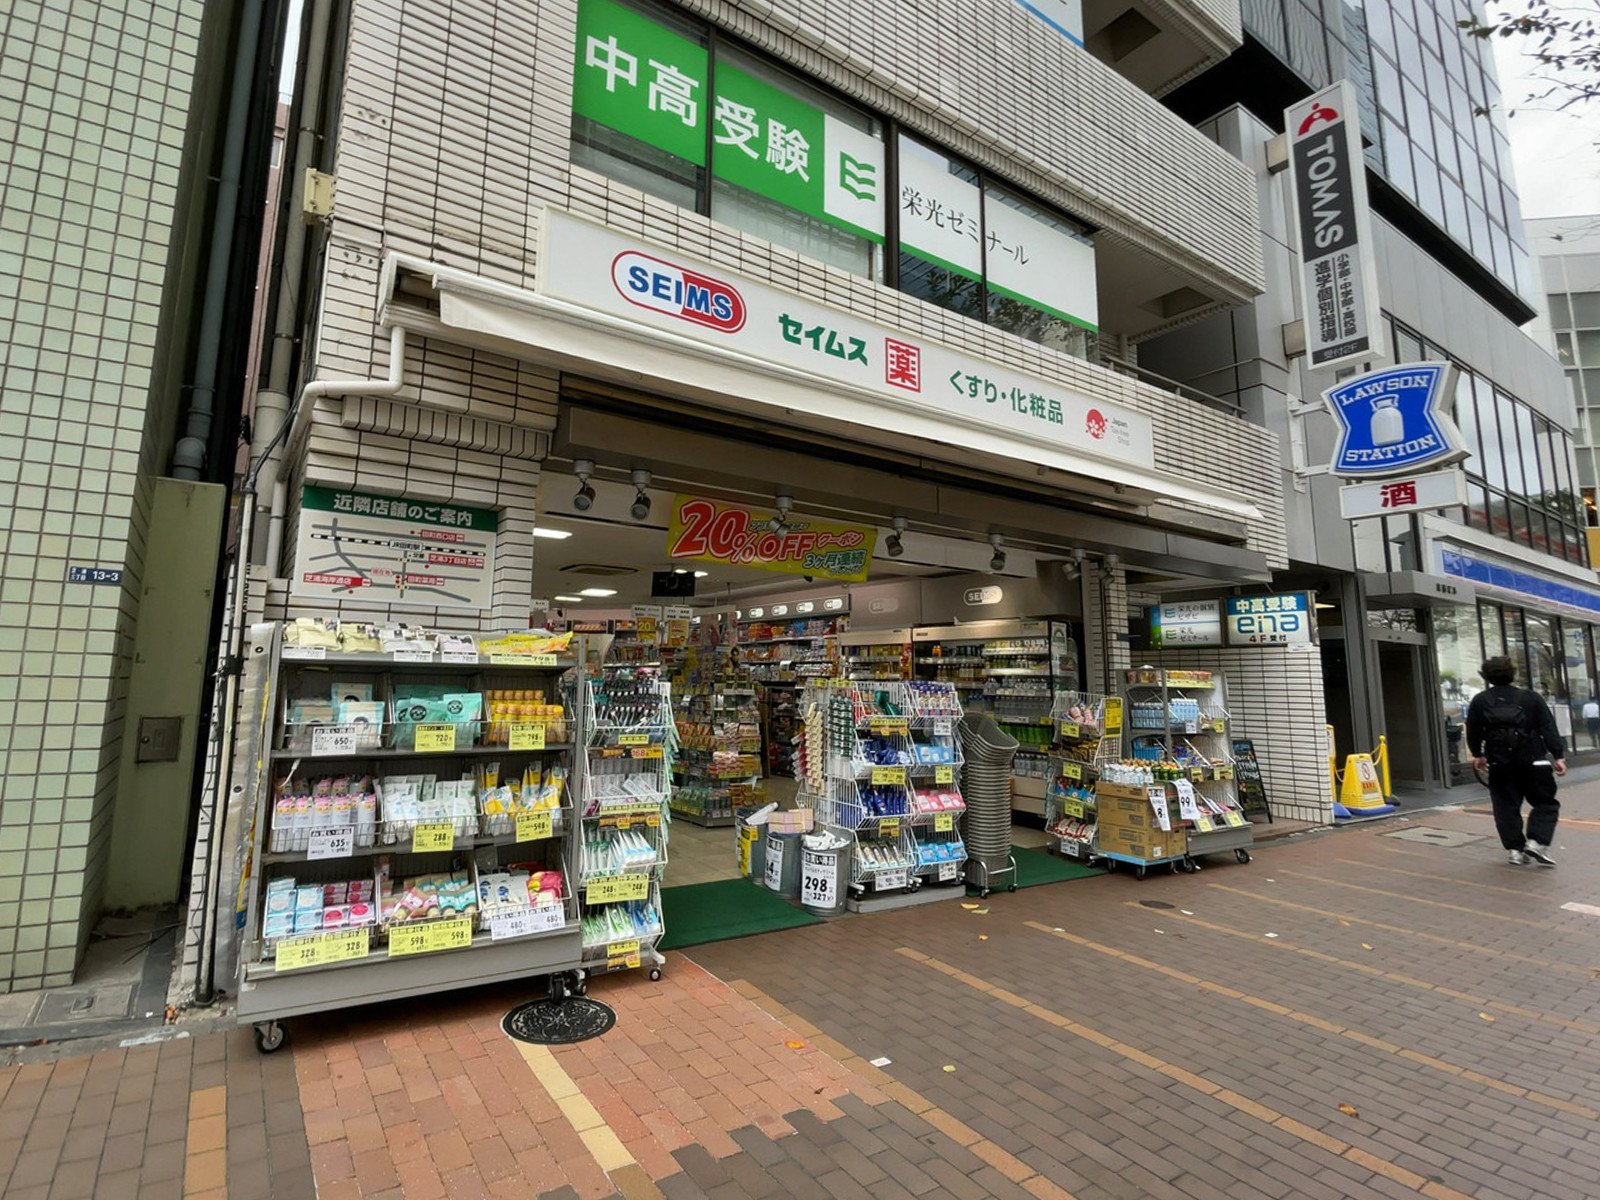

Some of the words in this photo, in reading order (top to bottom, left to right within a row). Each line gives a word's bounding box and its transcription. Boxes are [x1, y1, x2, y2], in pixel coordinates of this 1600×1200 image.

[585, 35, 811, 184] 中高受験
[1307, 134, 1344, 249] TOMAS
[901, 184, 1030, 266] 栄光ゼミナール
[628, 265, 732, 321] SEIMS
[778, 312, 868, 366] セイムス
[889, 345, 918, 387] 薬
[949, 369, 1064, 425] くすり・化粧品
[1339, 375, 1430, 406] LAWSON
[1345, 434, 1437, 462] STATION
[1380, 481, 1417, 508] 酒
[333, 494, 473, 526] 近隣店舗のご案内
[92, 570, 119, 582] 13-3
[1236, 596, 1297, 613] 中高受験
[1237, 614, 1299, 634] ena
[334, 737, 349, 745] 650
[435, 734, 449, 742] 720
[1181, 797, 1190, 807] 99
[330, 839, 346, 848] 635
[805, 876, 828, 892] 298
[813, 892, 827, 901] 327
[410, 936, 425, 946] 598
[451, 930, 465, 941] 598
[300, 948, 316, 959] 328
[346, 941, 361, 952] 328
